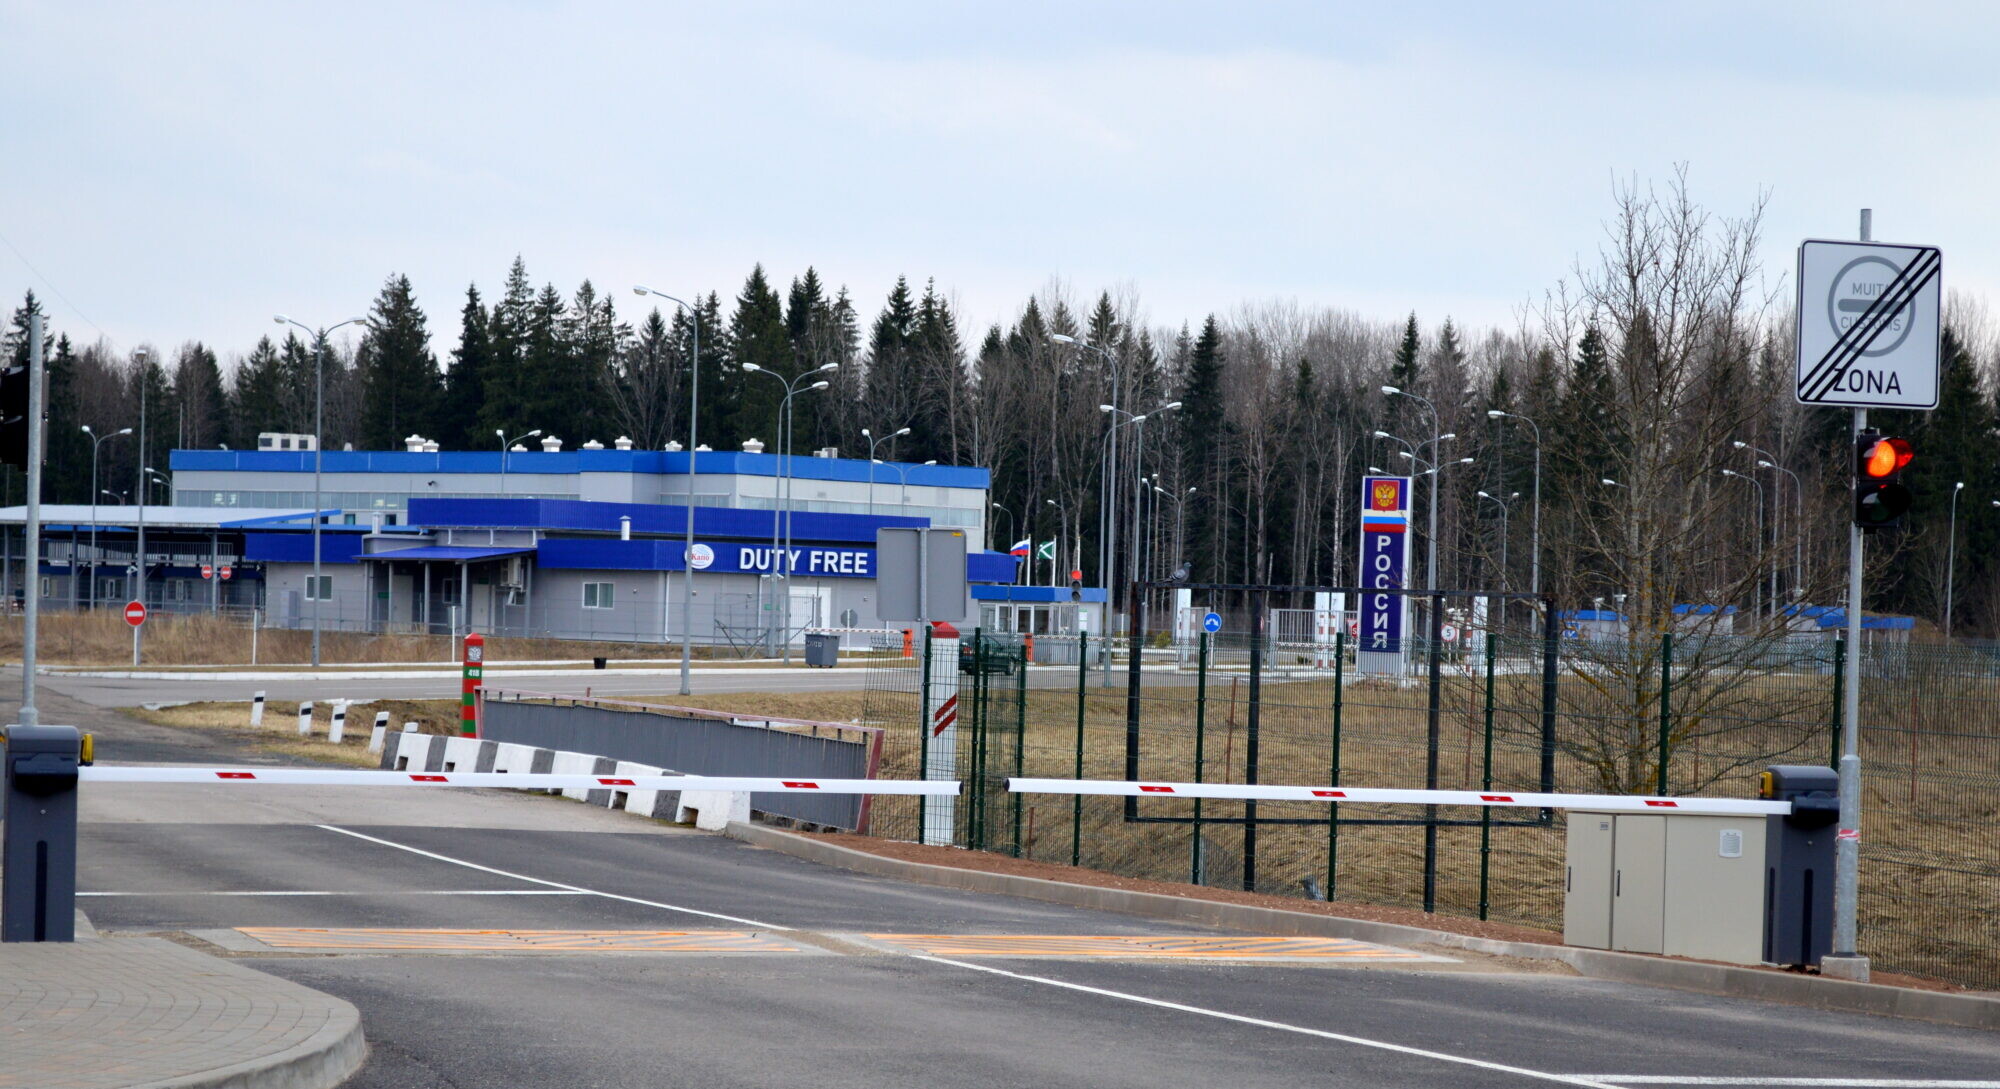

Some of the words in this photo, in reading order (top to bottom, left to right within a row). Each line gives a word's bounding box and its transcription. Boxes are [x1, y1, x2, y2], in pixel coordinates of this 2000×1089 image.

[1851, 282, 1892, 296] MUITA
[1841, 316, 1901, 332] CUSTOMS
[1832, 368, 1902, 395] ZONA
[739, 548, 801, 571] DUTY
[809, 550, 868, 574] FREE
[1372, 535, 1391, 648] РОССИЯ
